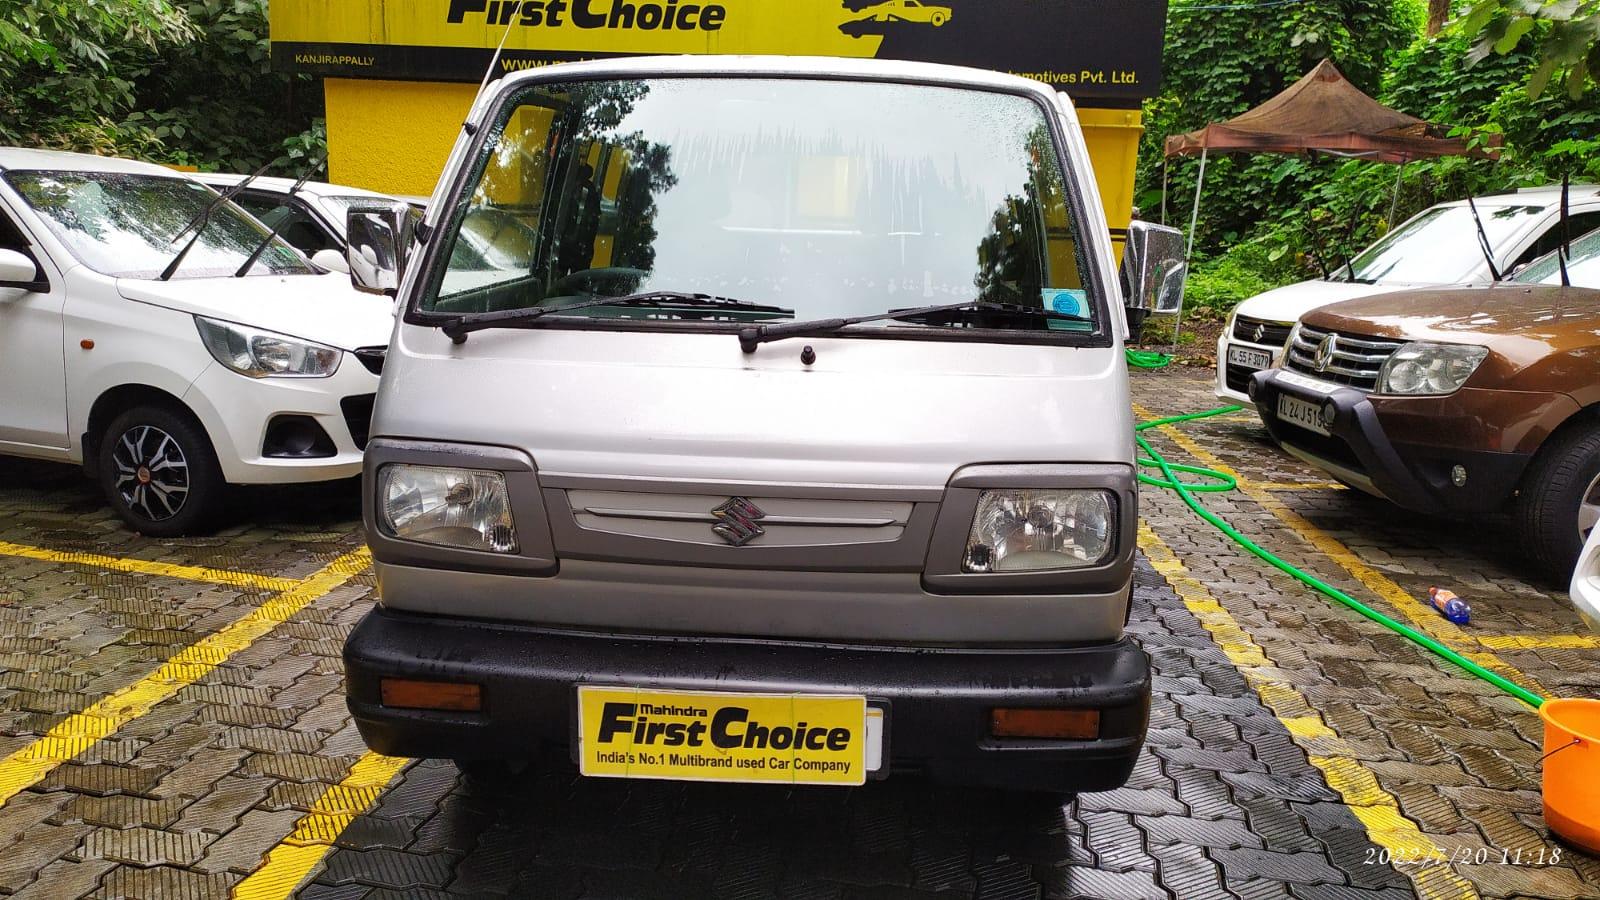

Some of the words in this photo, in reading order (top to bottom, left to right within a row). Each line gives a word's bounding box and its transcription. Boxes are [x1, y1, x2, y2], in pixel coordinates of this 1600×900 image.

[571, 0, 726, 31] Choice
[295, 54, 375, 66] KANJIRAPPALLY
[1080, 71, 1107, 84] Pvt.
[1111, 71, 1139, 84] Ltd.
[1239, 350, 1247, 363] 55
[1289, 402, 1299, 419] 24
[640, 704, 708, 717] Mahindra
[597, 701, 707, 747] First
[710, 706, 851, 752] Choice
[597, 751, 635, 765] India's
[638, 752, 665, 766] No.1
[669, 753, 733, 769] Multibrand
[736, 757, 765, 769] used
[769, 757, 791, 770] Car
[793, 757, 851, 775] Company
